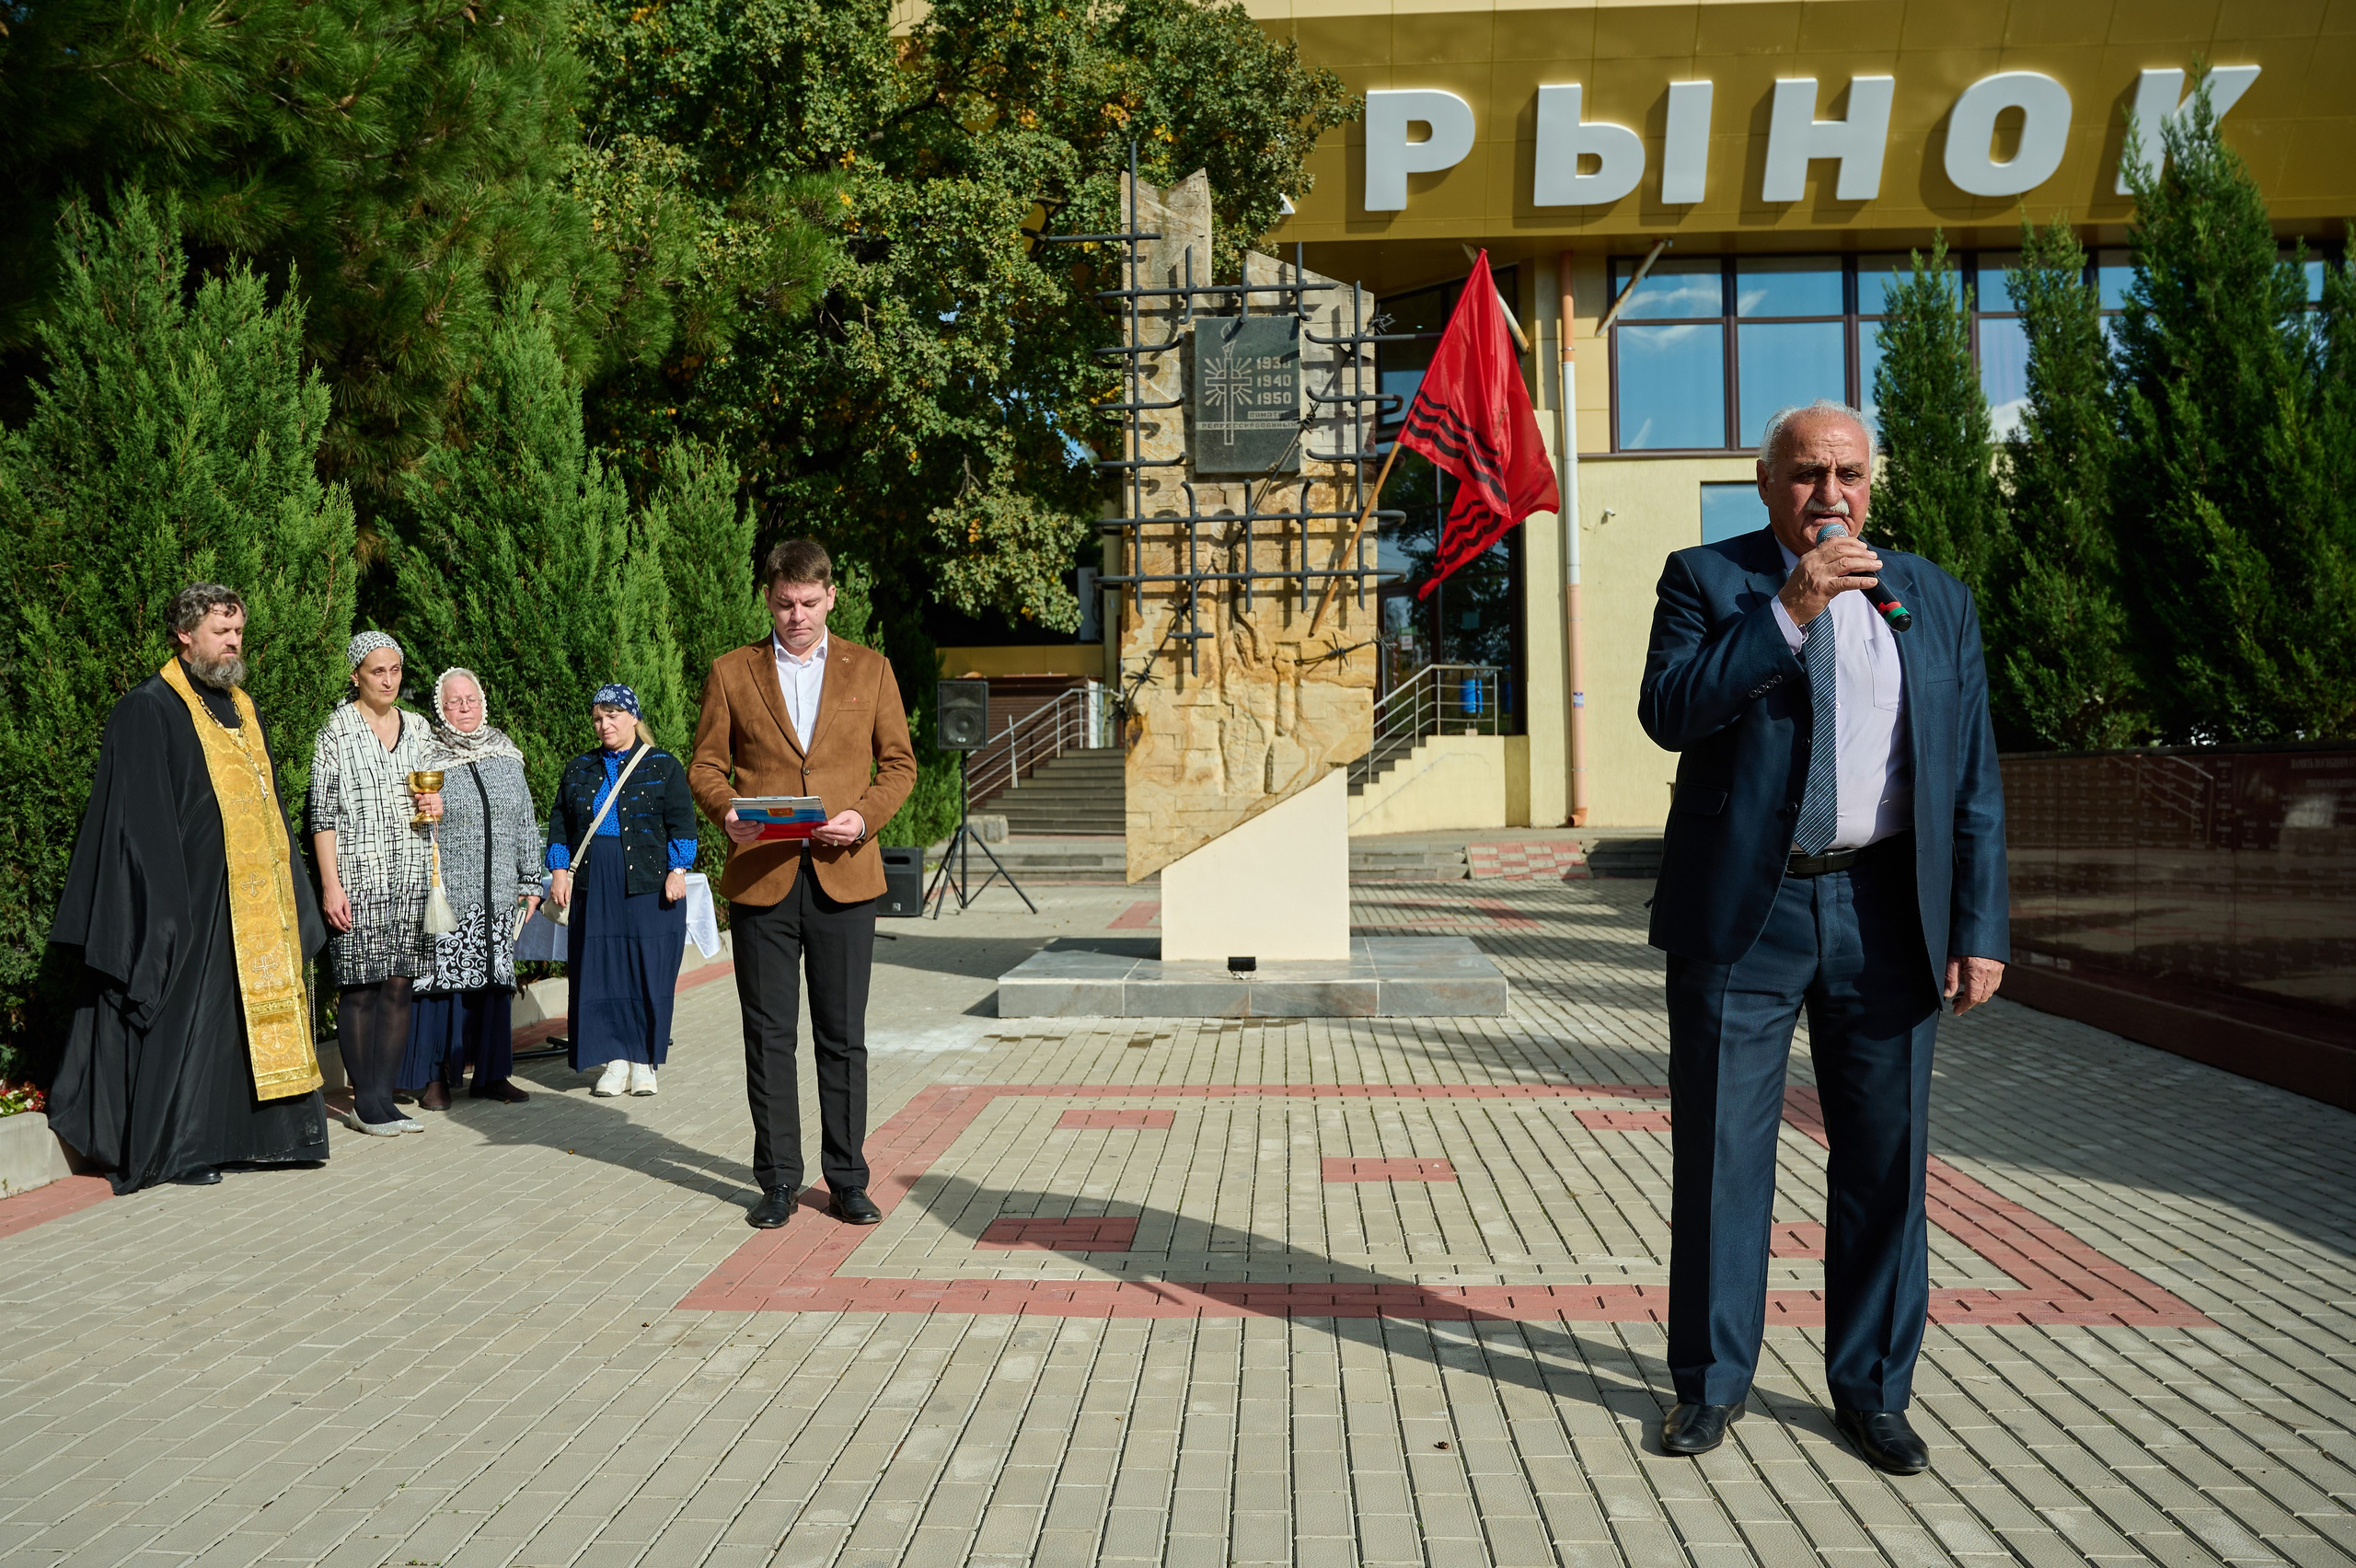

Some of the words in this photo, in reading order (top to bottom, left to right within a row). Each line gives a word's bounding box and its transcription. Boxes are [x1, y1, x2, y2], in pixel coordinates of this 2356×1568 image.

[1365, 63, 2262, 212] РЫНОК
[1257, 375, 1292, 387] 1940
[1257, 391, 1292, 405] 1950
